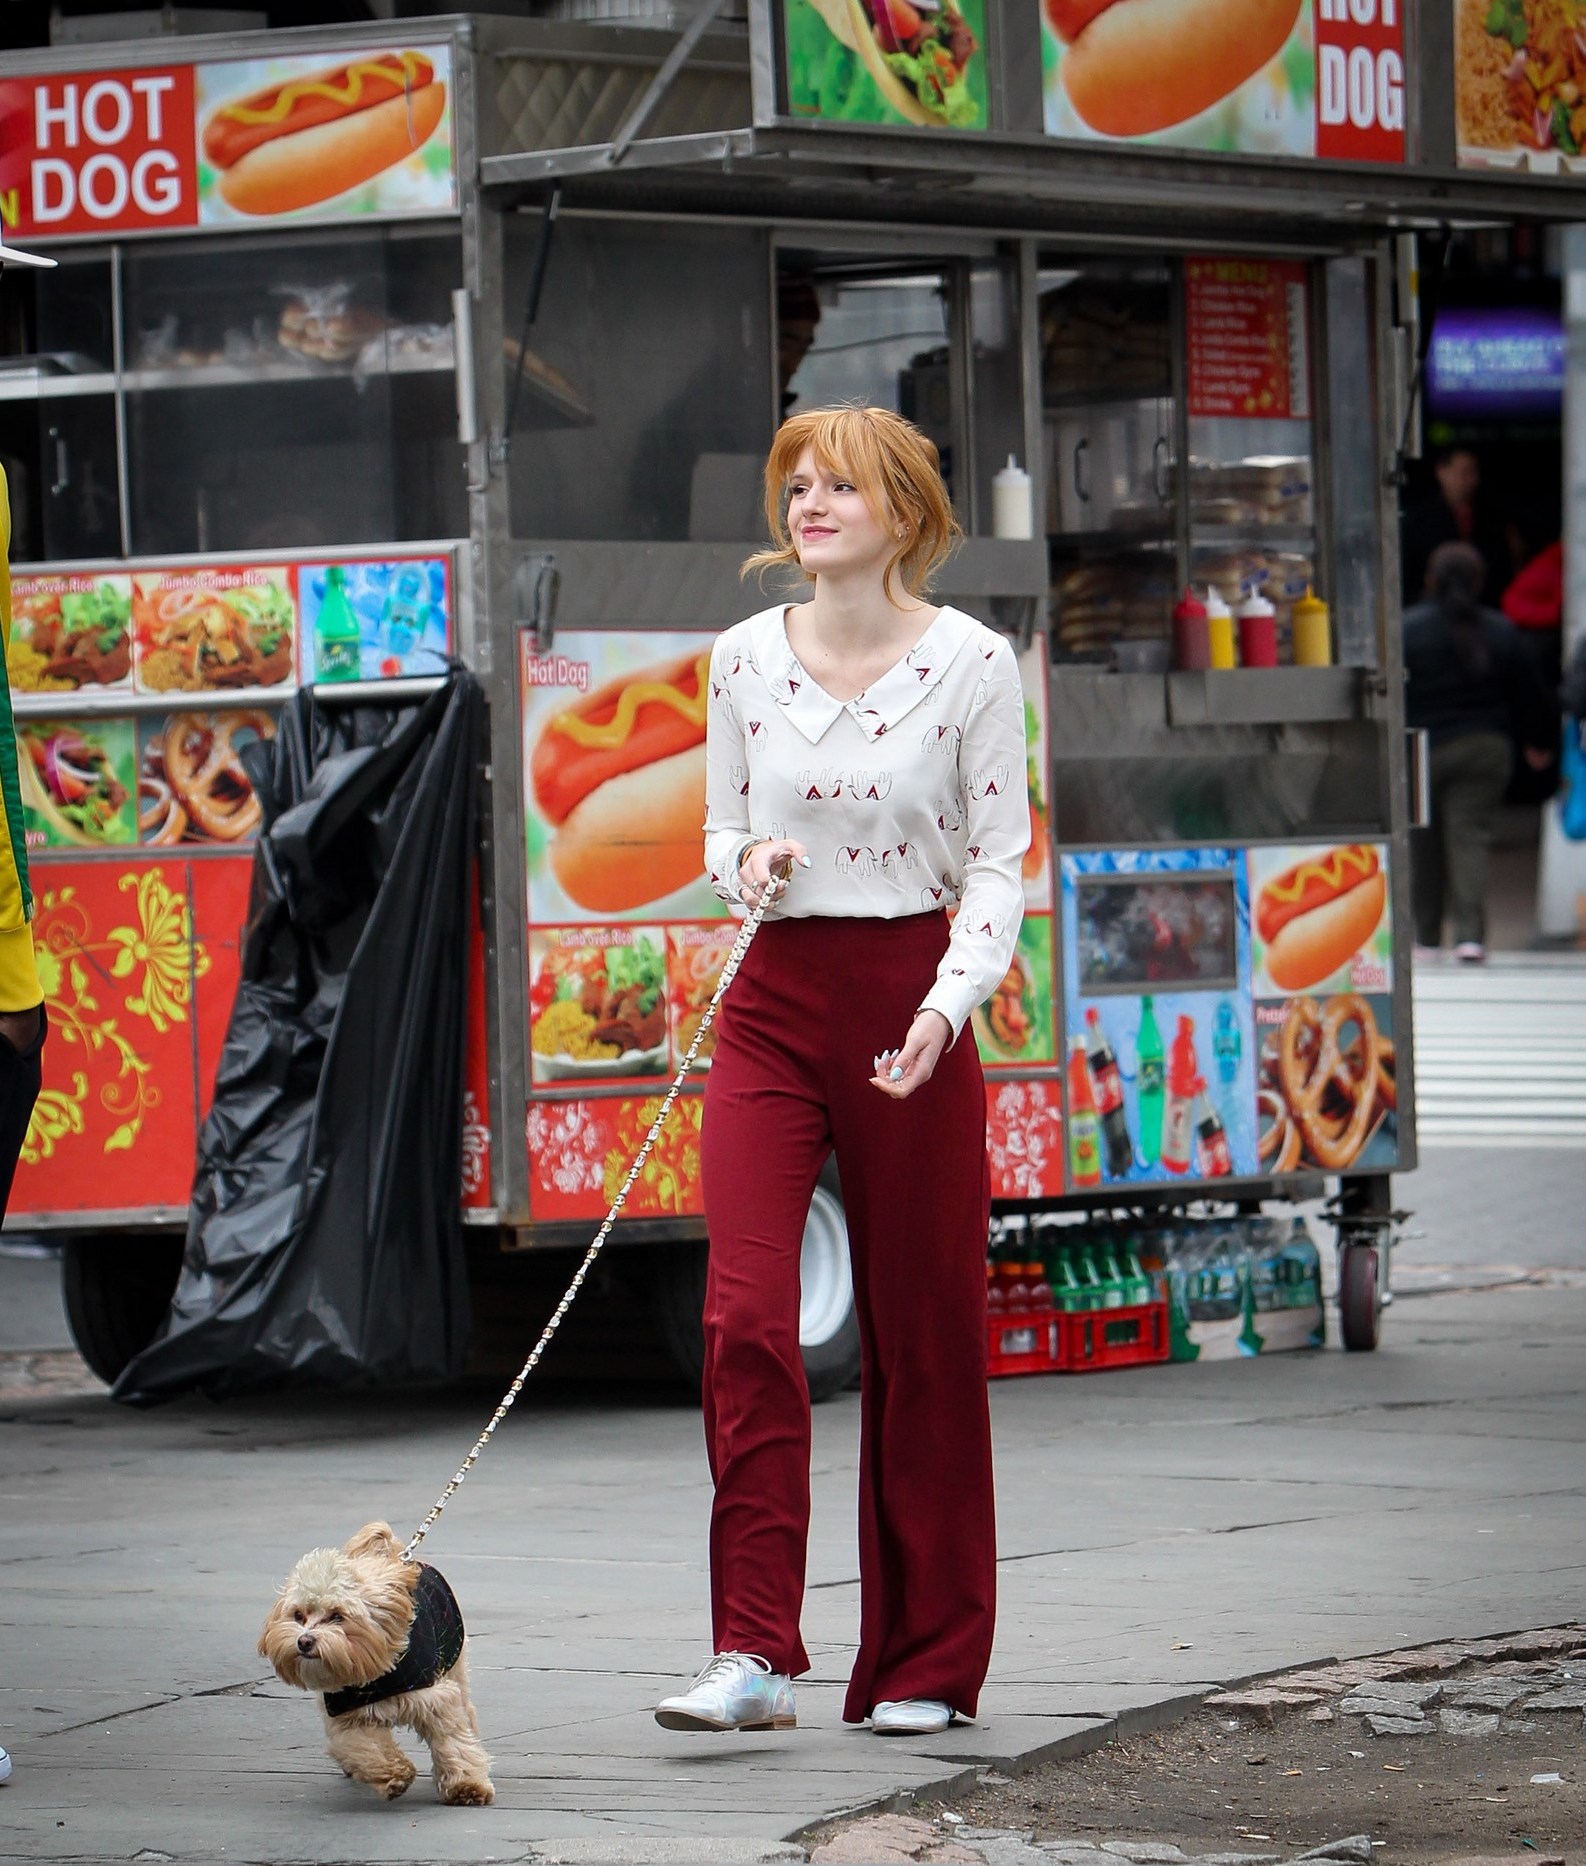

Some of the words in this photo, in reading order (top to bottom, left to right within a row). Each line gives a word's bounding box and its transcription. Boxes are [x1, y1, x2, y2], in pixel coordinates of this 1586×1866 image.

[1319, 44, 1405, 132] DOG
[35, 76, 175, 150] HOT
[31, 149, 182, 223] DOG
[161, 576, 198, 590] Jumbo
[200, 573, 243, 589] Combo
[243, 571, 268, 587] Rice
[527, 656, 554, 685] Hot
[557, 657, 588, 691] Dog
[26, 829, 47, 847] yro
[559, 929, 585, 946] Lamb
[587, 931, 610, 946] over
[611, 927, 634, 945] Rice
[681, 929, 712, 946] Jumbo
